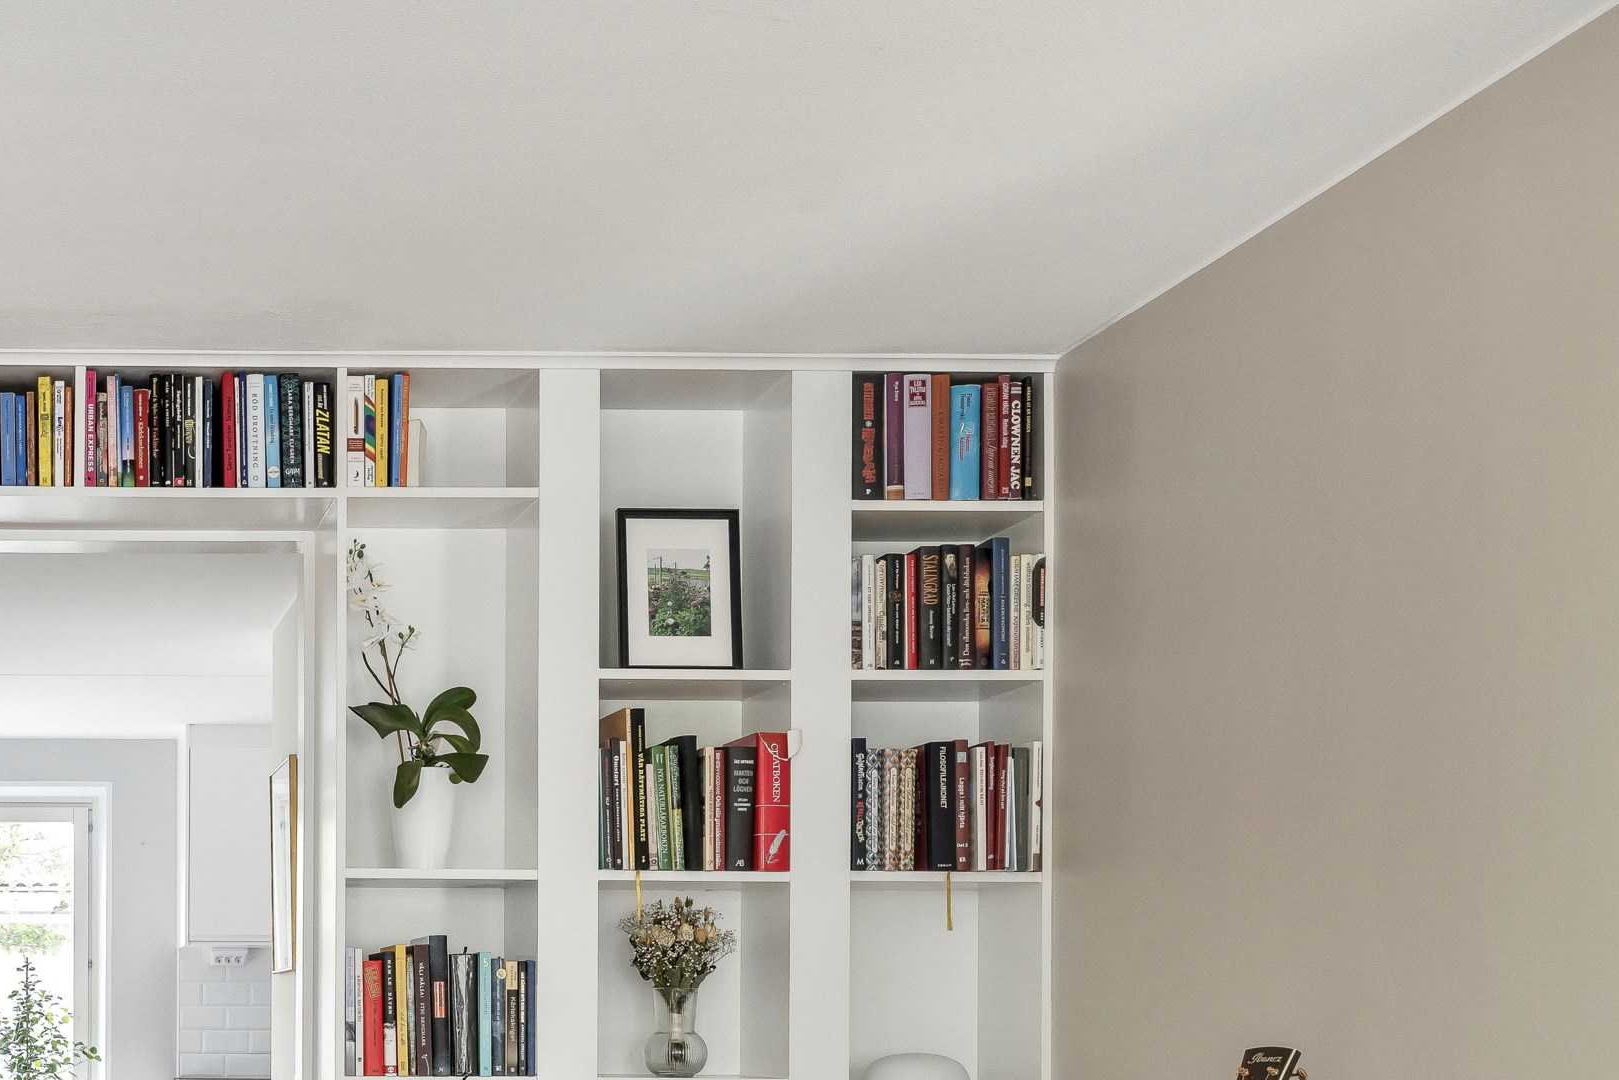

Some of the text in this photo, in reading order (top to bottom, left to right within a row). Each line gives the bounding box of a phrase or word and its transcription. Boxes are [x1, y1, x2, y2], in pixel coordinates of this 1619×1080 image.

[315, 409, 331, 454] ZLATAN
[1010, 399, 1021, 490] CLOWNEN JAC
[937, 454, 945, 493] JAGUAREN
[923, 555, 938, 605] STALINGRAD
[638, 769, 646, 817] RÄTTMÄTIGA
[770, 743, 780, 802] CITATBOKEN
[658, 784, 668, 854] NATURLÄKARBOKEN
[1247, 1052, 1283, 1064] Ibanez
